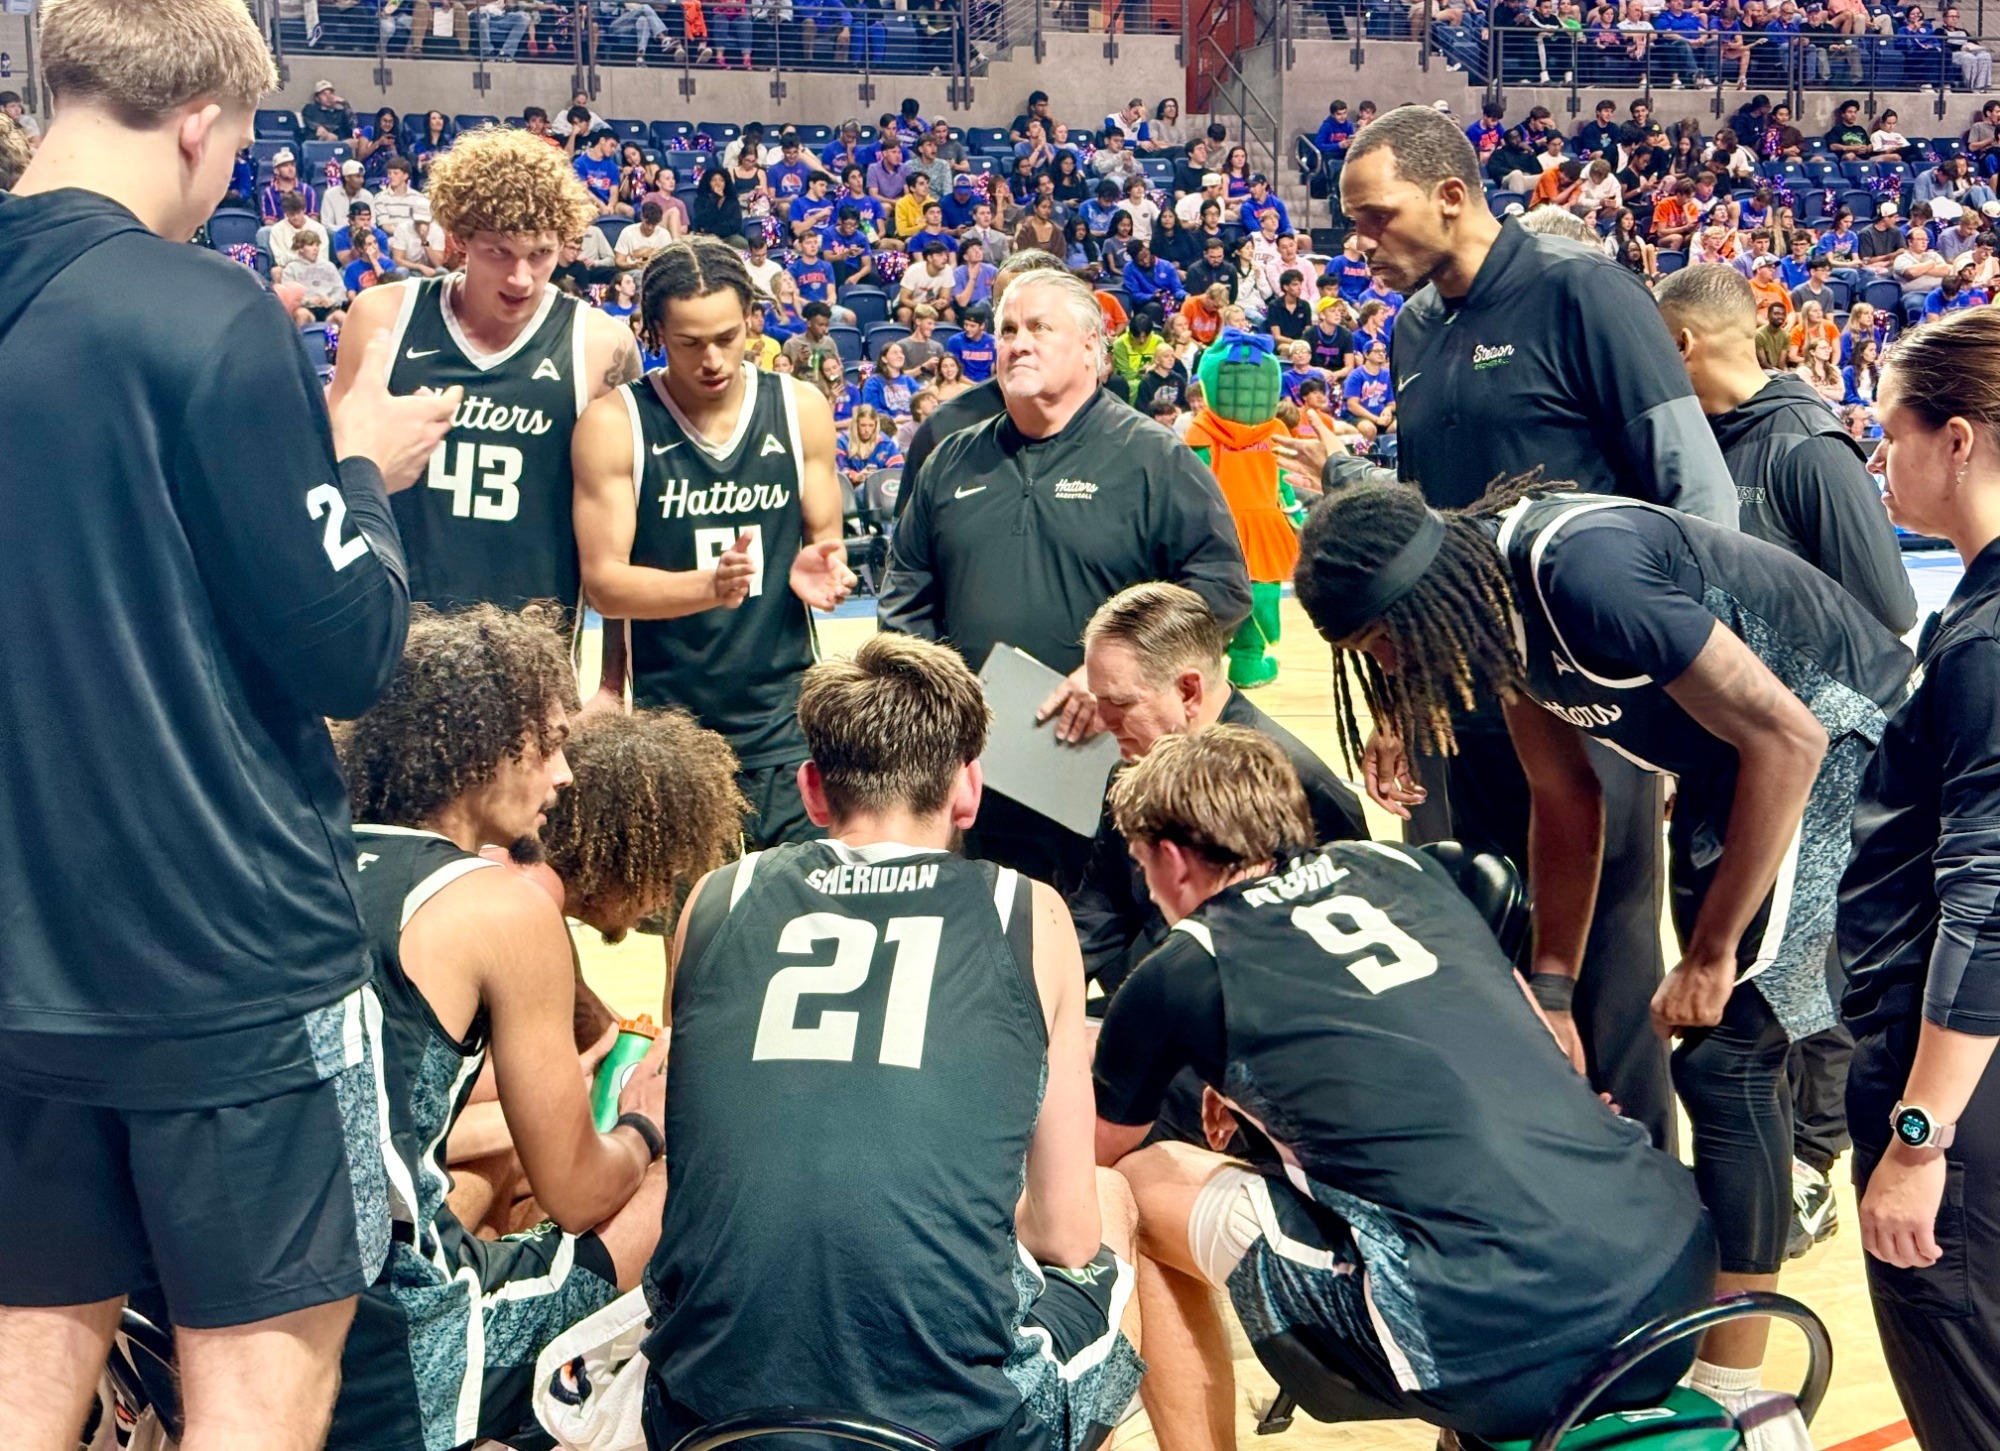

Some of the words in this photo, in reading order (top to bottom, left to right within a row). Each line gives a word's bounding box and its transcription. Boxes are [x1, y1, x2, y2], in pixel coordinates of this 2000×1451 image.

[427, 440, 523, 521] 43
[658, 479, 790, 518] Hatters
[1054, 478, 1099, 493] Hatters
[804, 864, 939, 895] SHERIDAN
[1291, 895, 1438, 995] 9
[753, 912, 944, 1069] 21
